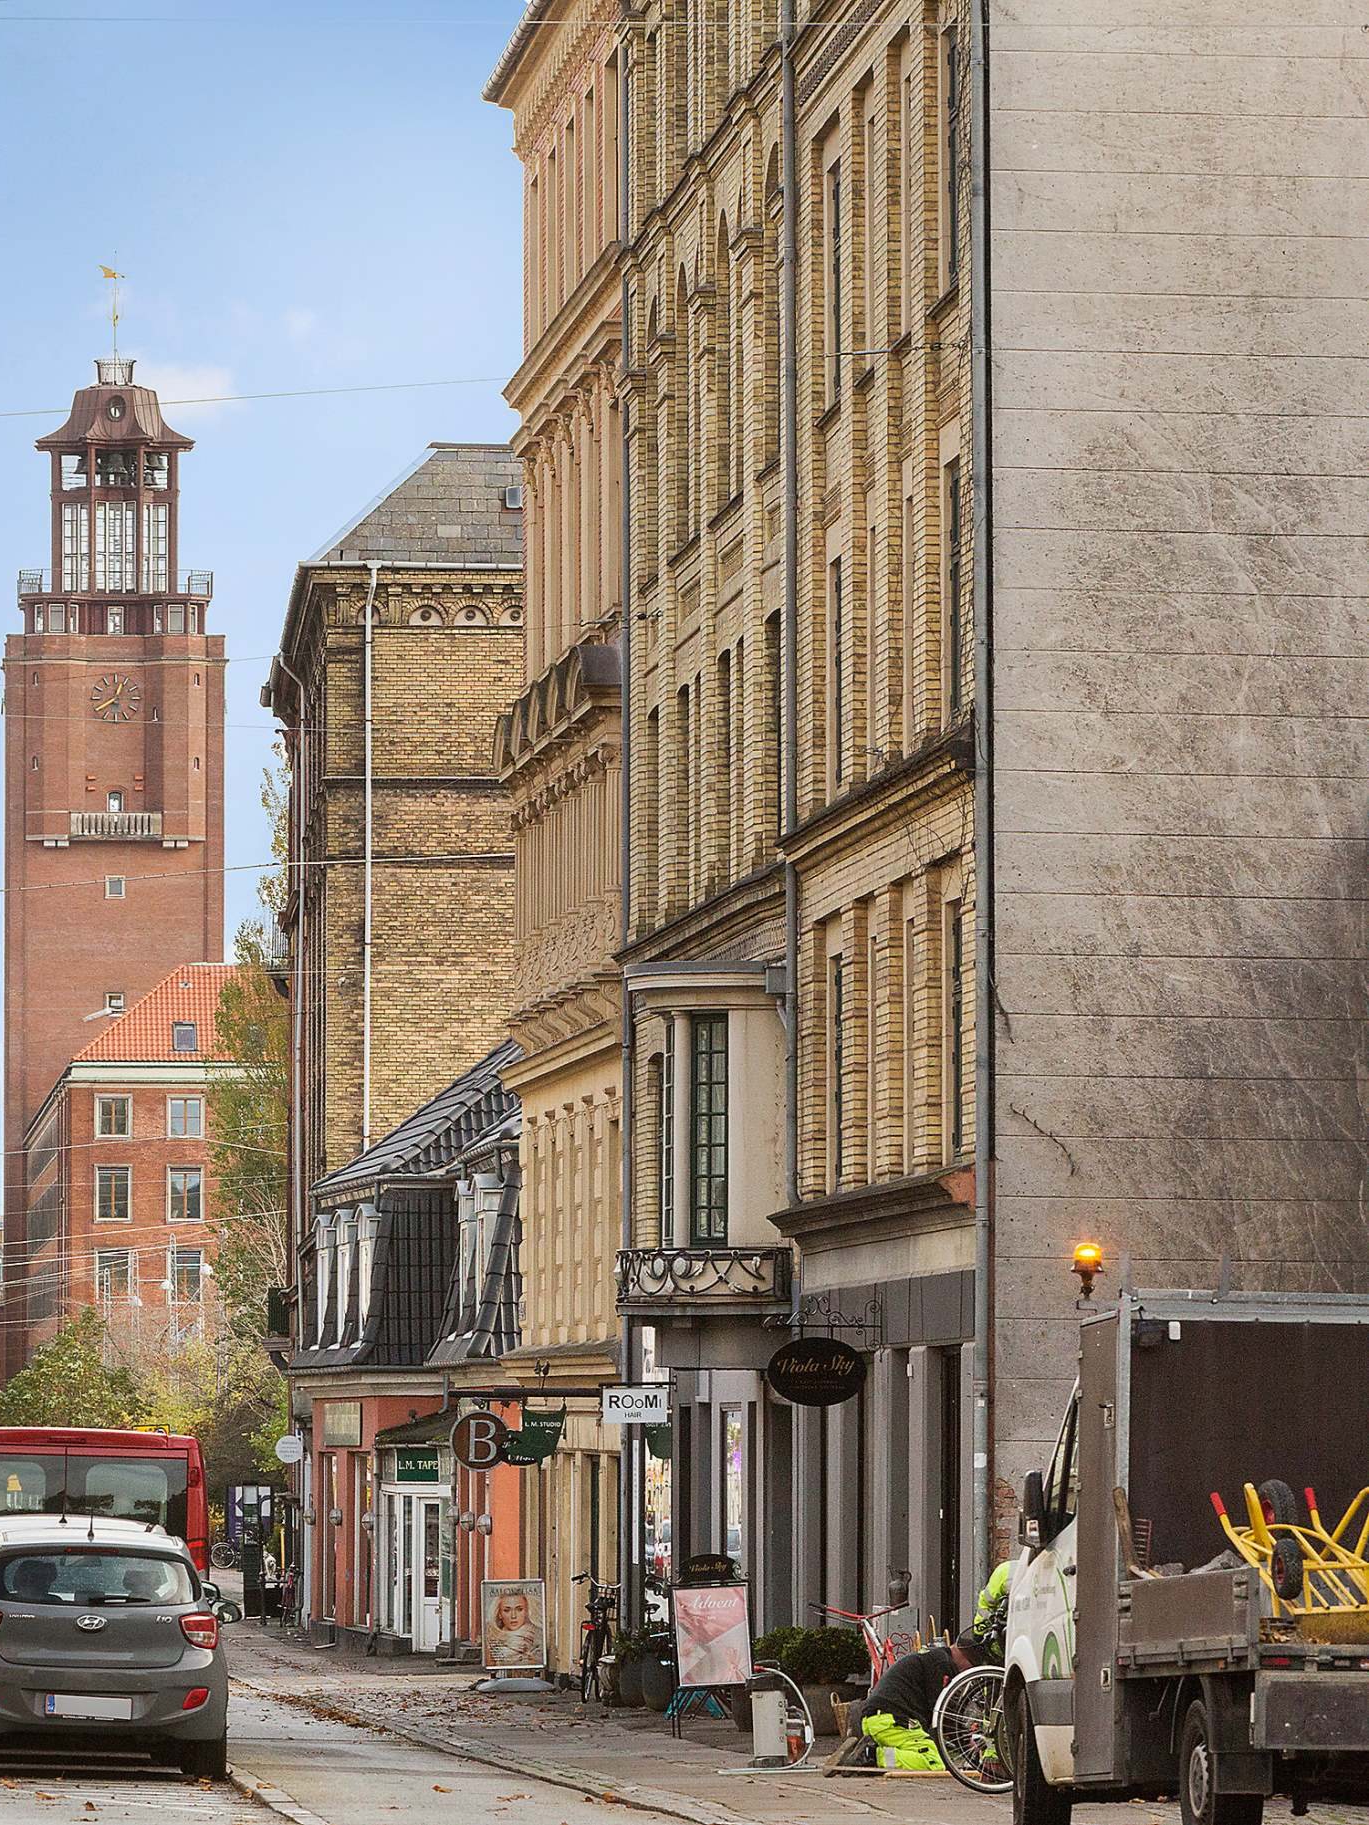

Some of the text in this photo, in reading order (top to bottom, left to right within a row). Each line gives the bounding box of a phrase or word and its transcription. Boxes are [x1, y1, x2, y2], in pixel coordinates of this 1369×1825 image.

[776, 1353, 856, 1376] Viola Sky
[468, 1420, 497, 1462] B
